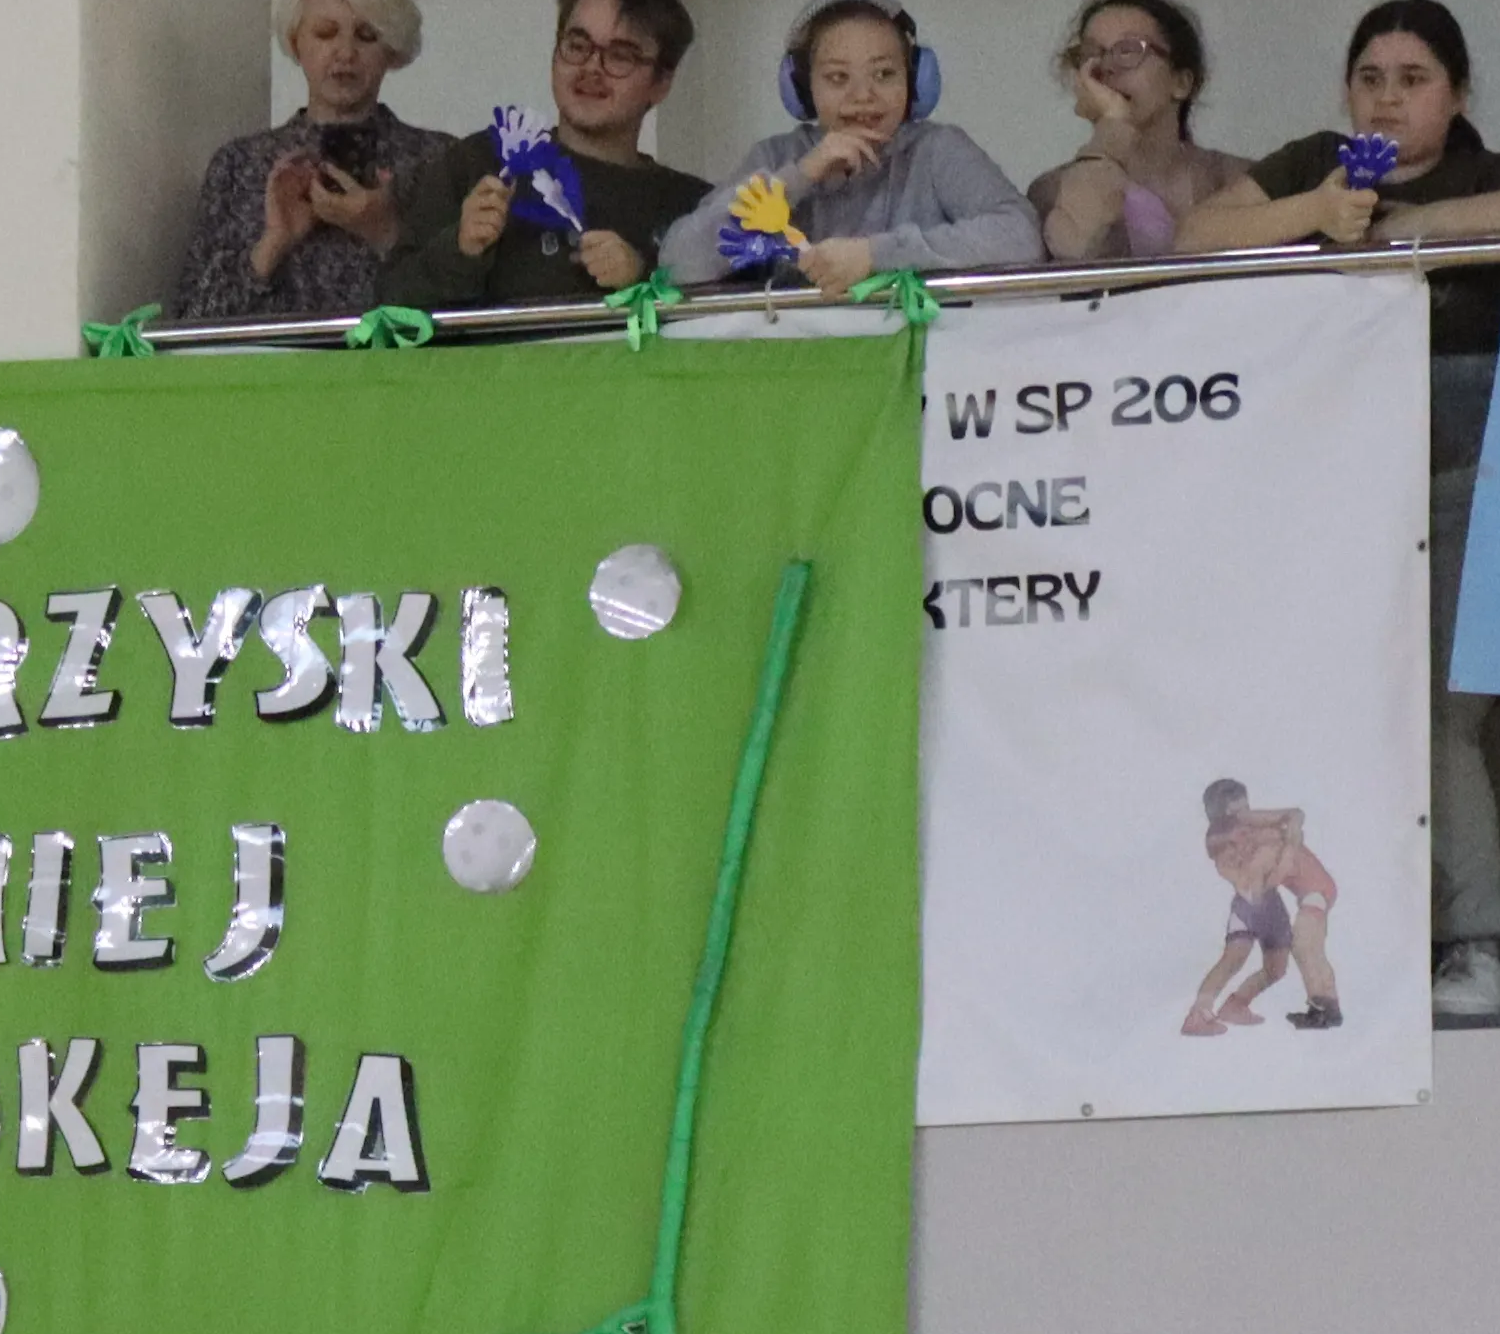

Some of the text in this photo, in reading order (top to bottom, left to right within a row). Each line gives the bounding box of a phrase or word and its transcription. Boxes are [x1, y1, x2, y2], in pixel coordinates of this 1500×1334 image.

[945, 371, 1243, 441] W SP 206
